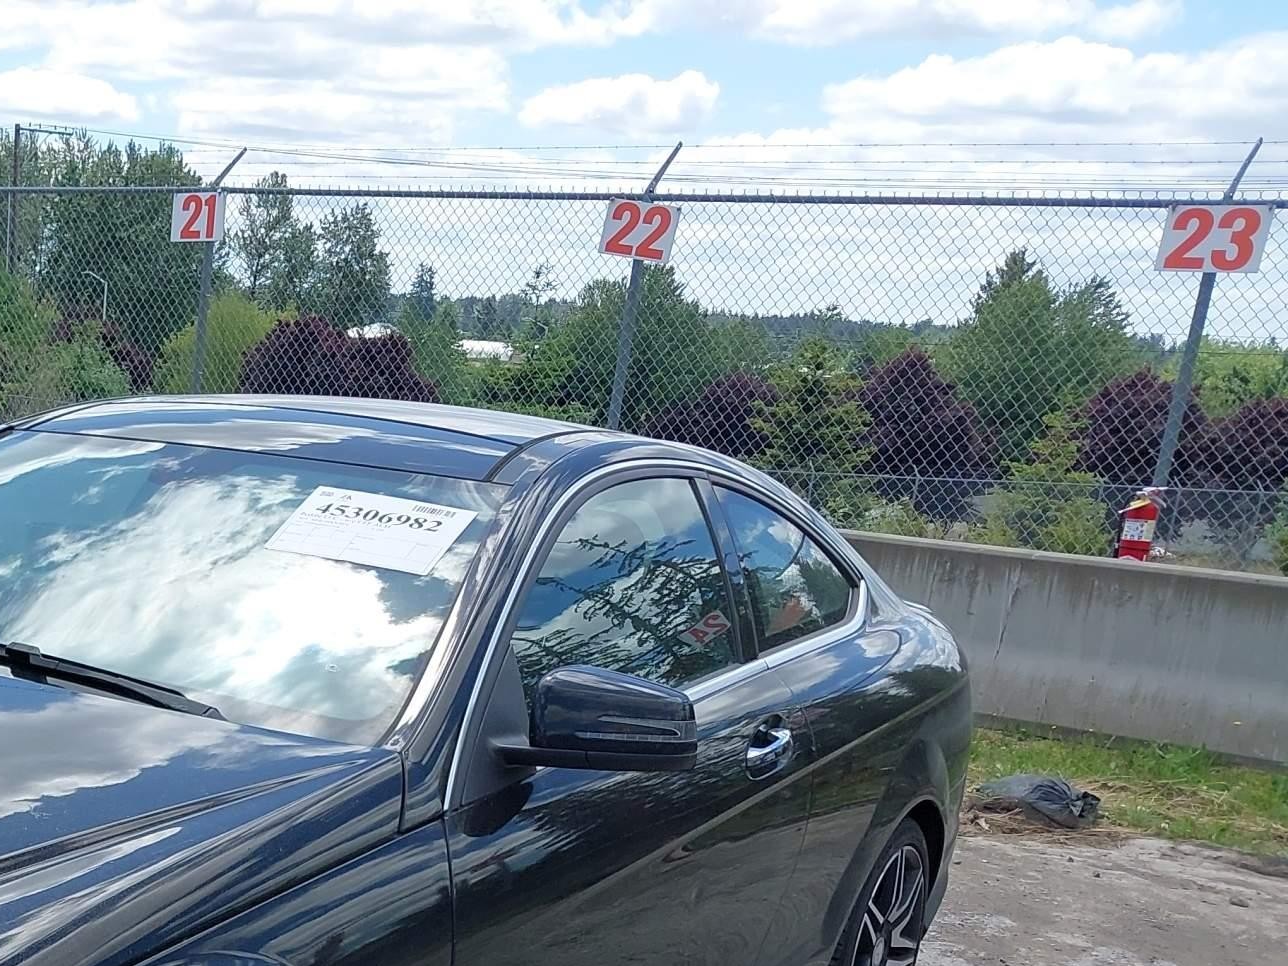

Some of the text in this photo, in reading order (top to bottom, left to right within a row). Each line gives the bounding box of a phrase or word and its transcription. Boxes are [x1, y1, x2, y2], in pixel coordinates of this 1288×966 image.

[180, 195, 217, 240] 21
[605, 201, 671, 260] 22
[1164, 208, 1261, 272] 23
[315, 502, 444, 533] 45306982
